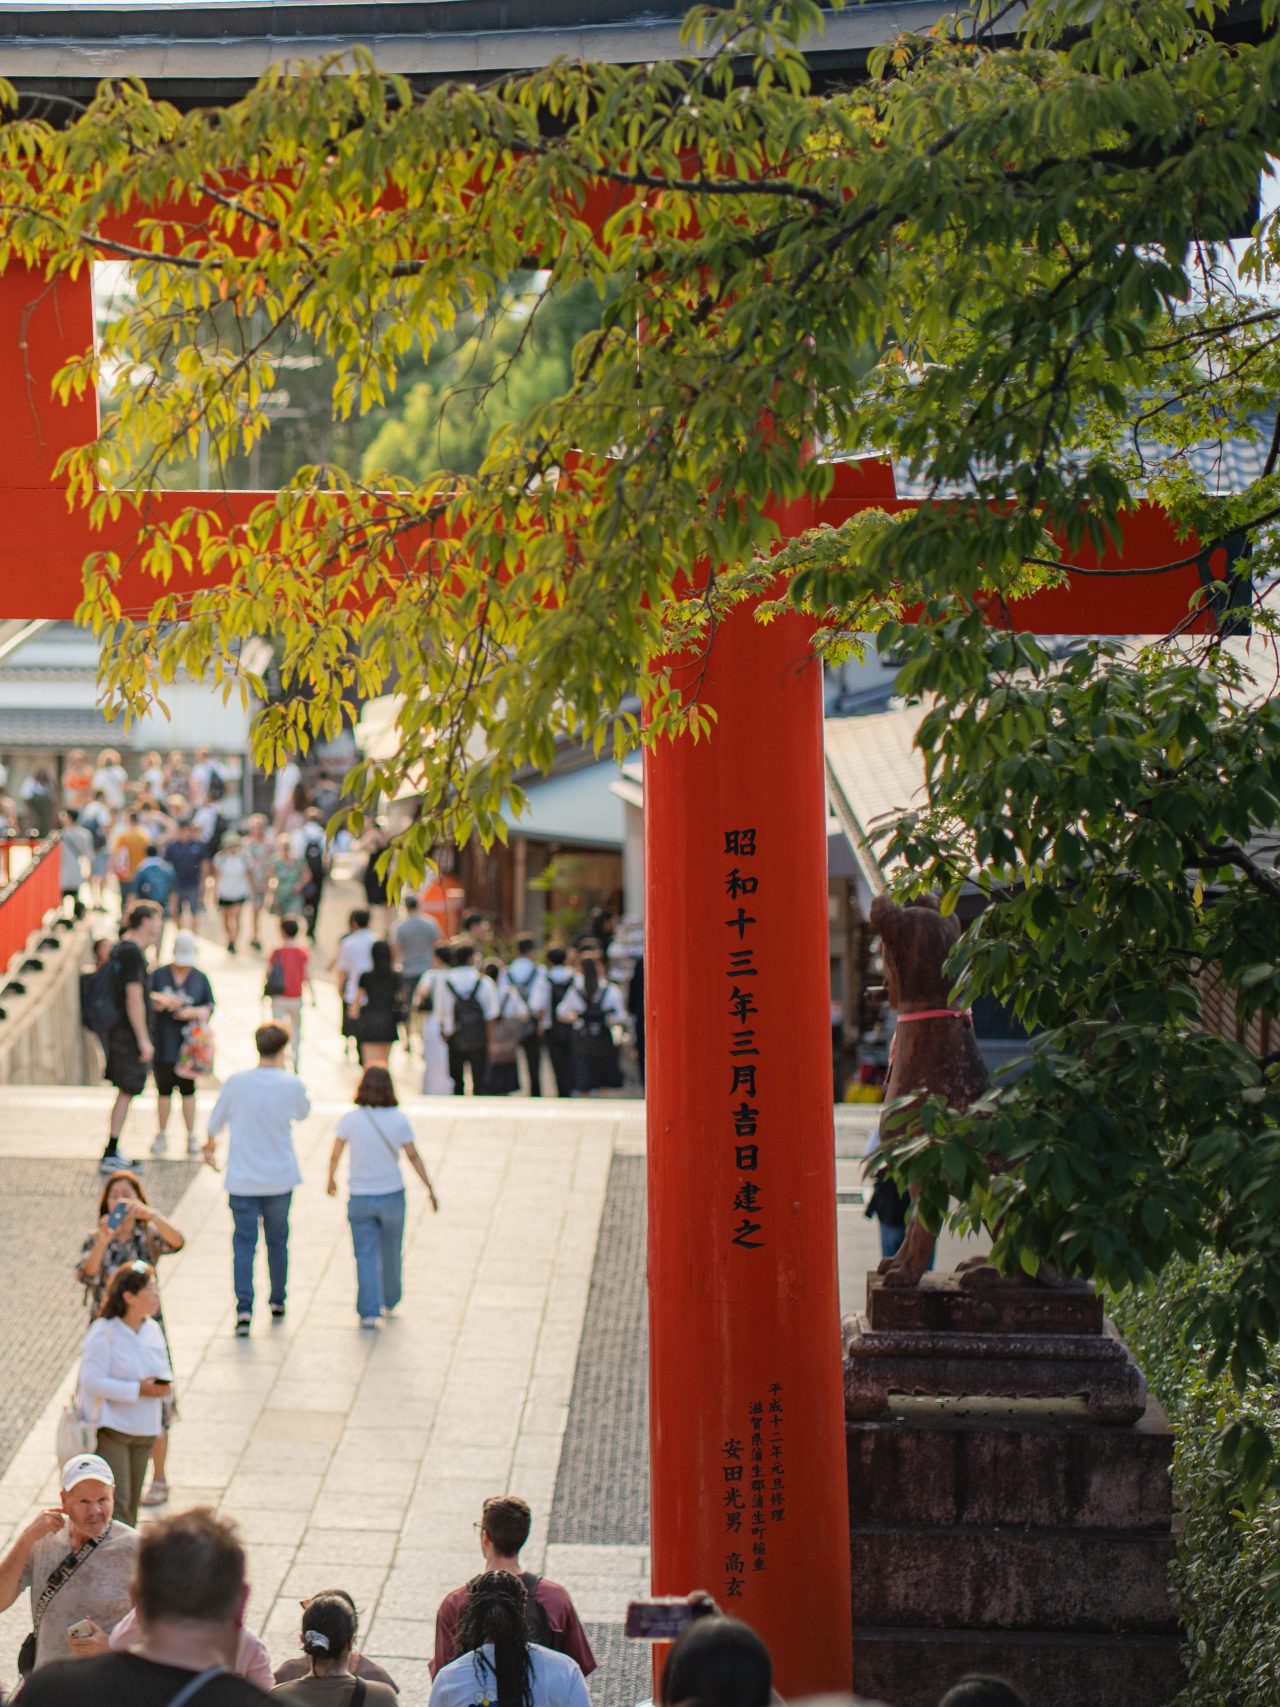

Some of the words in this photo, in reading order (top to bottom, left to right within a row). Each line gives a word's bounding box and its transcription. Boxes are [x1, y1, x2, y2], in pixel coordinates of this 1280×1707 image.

[723, 828, 766, 1250] 昭和十三年三月吉日建之
[722, 1438, 746, 1533] 安田光男
[767, 1383, 785, 1522] 平成十二年元旦修理
